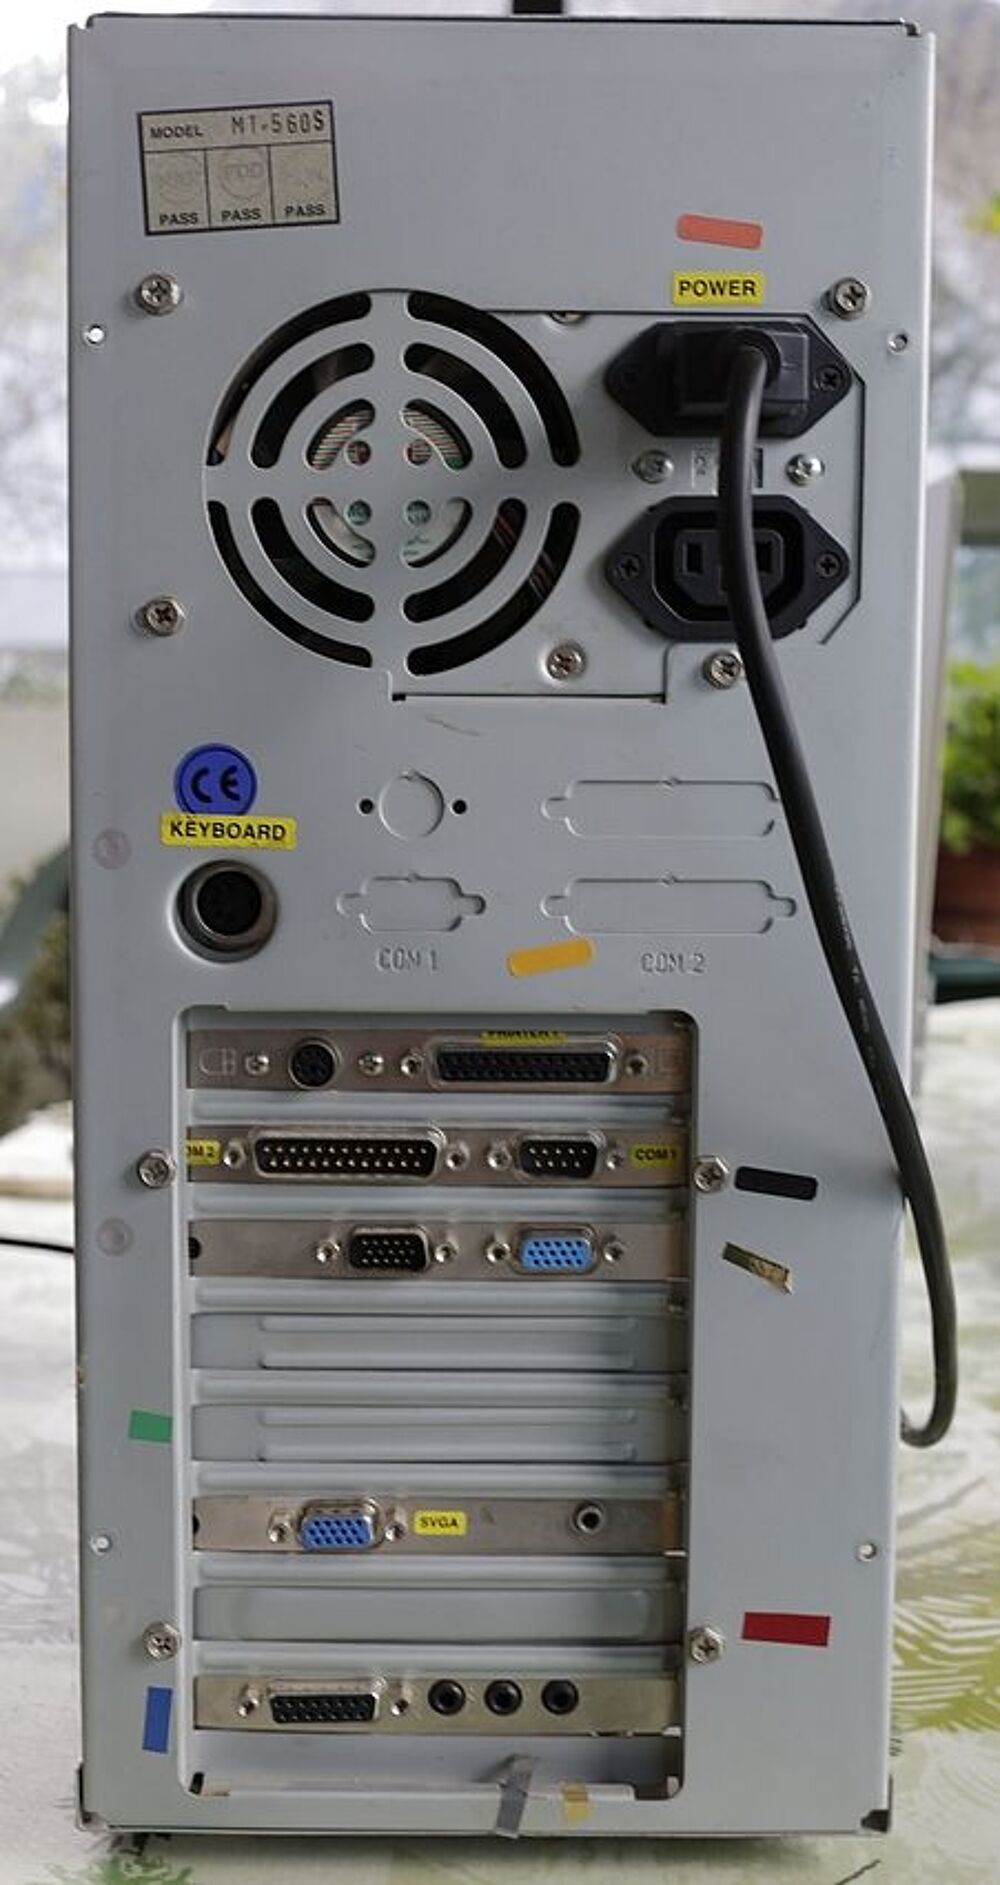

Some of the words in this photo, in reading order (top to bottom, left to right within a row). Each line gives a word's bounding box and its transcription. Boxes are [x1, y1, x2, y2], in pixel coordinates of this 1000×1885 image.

[150, 125, 203, 138] MODEL
[221, 208, 262, 221] PASS
[284, 203, 326, 216] PASS
[160, 212, 199, 225] PASS
[679, 279, 757, 297] POWER
[190, 765, 241, 803] CE
[170, 820, 286, 841] KEYBOARD
[379, 948, 421, 970] COM
[641, 953, 685, 973] COM
[692, 952, 705, 974] 2
[420, 1516, 460, 1529] SVGA
